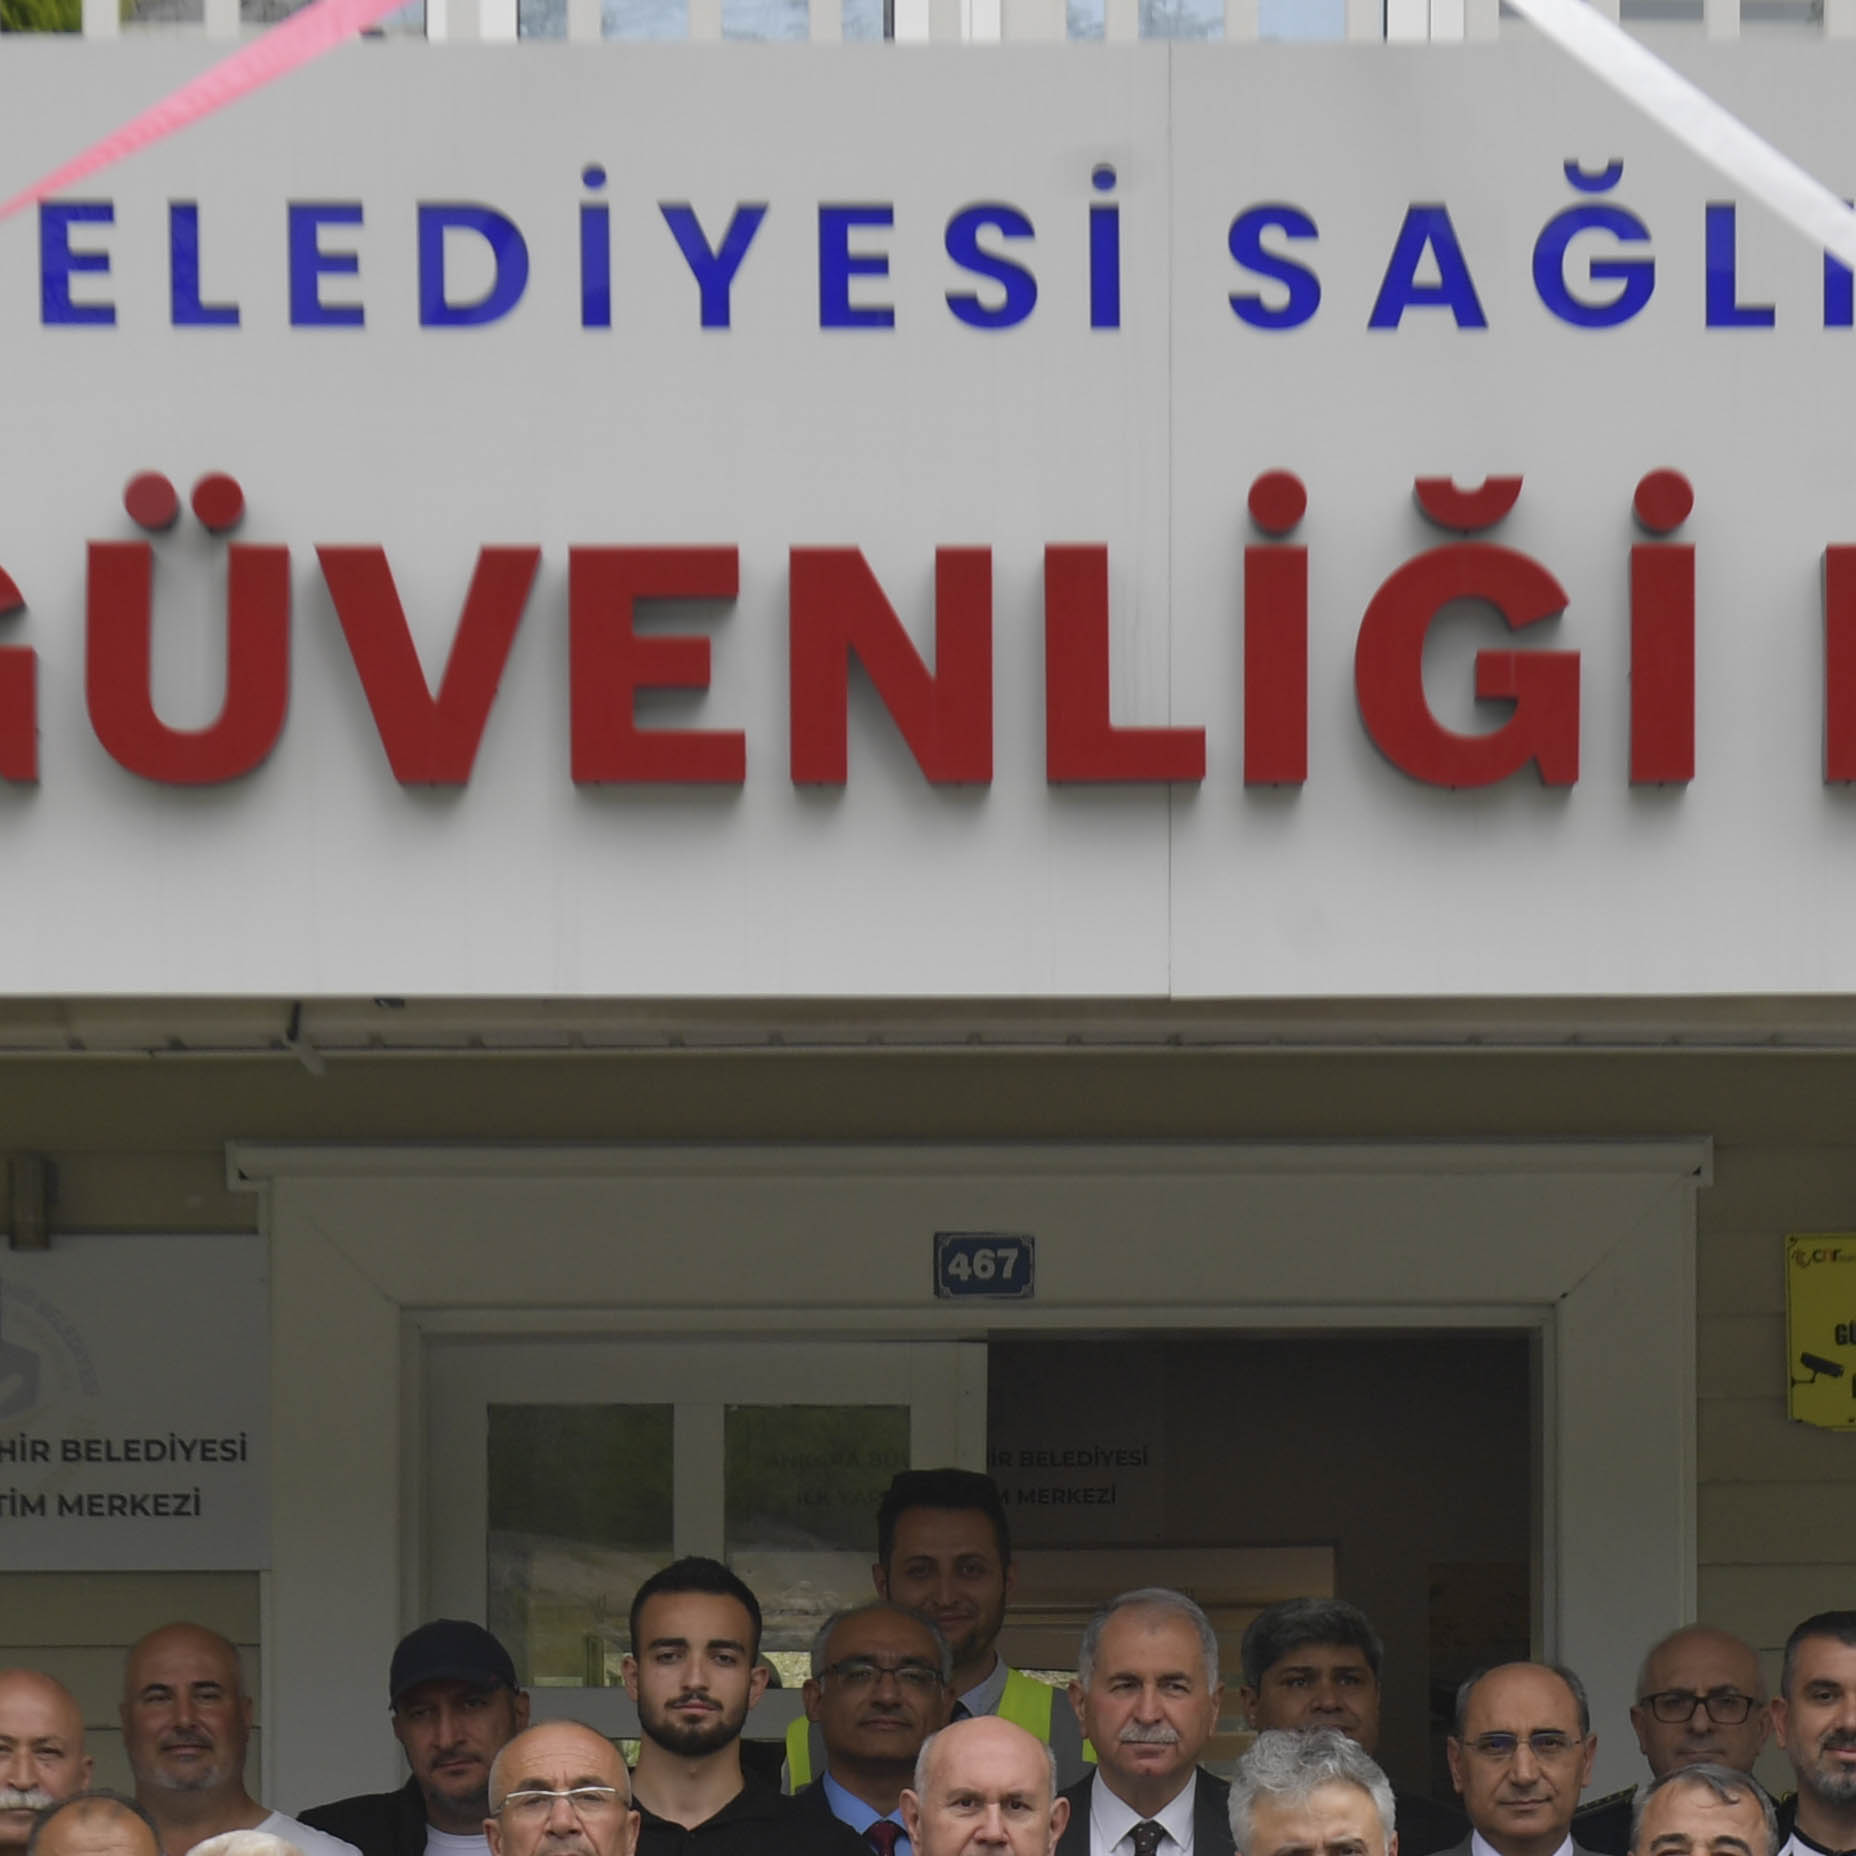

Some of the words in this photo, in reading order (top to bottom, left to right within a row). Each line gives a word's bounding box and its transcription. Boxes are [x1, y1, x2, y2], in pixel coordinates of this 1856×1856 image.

[949, 1248, 1018, 1281] 467
[60, 1431, 249, 1463] BELEDİYESİ
[57, 1485, 202, 1518] MERKEZİ
